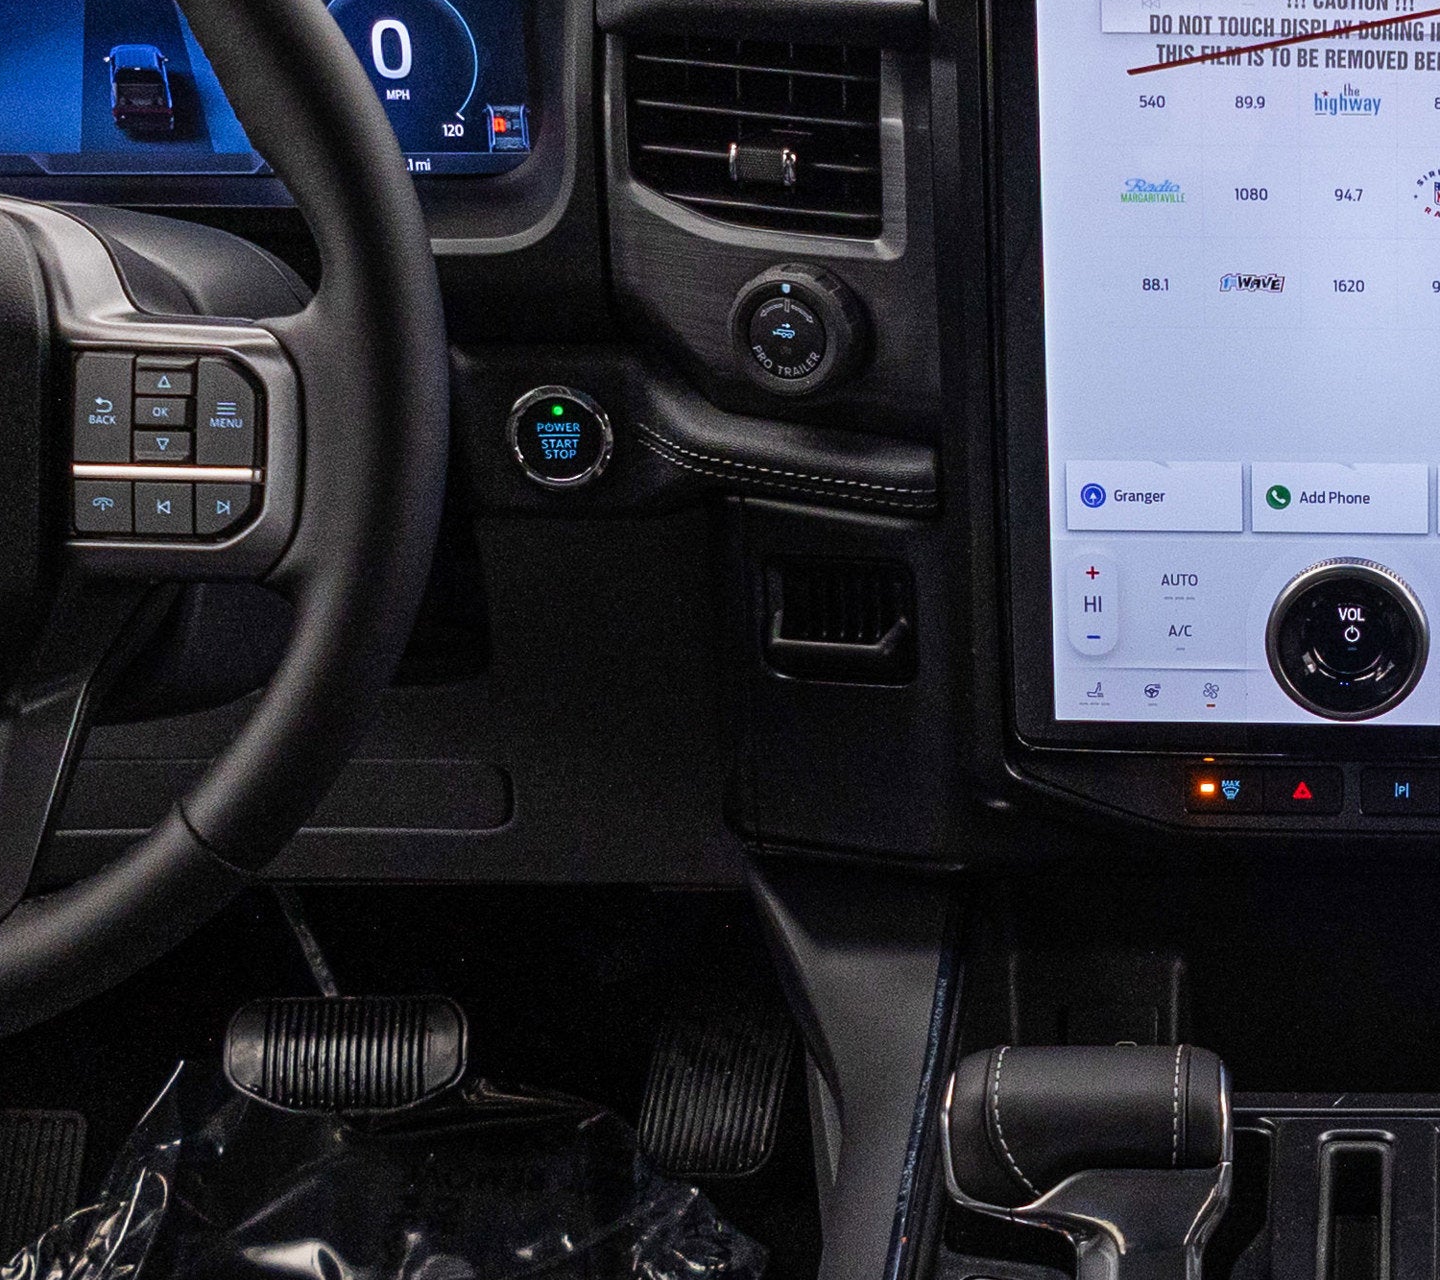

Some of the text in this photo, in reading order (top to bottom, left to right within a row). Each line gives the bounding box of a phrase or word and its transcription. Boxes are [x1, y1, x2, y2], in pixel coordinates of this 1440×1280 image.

[1149, 14, 1173, 35] DO
[1178, 15, 1213, 36] NOT
[1218, 16, 1275, 38] TOUCH
[1280, 18, 1352, 40] DISPLAY
[1357, 20, 1424, 42] DURING
[371, 19, 412, 80] 0
[1156, 43, 1195, 65] THIS
[1201, 45, 1242, 66] FILM
[1247, 47, 1265, 67] IS
[1270, 47, 1291, 68] TO
[1296, 48, 1319, 69] BE
[1324, 49, 1409, 71] REMOVED
[386, 89, 411, 101] MPH
[1343, 83, 1360, 96] the
[1139, 95, 1166, 109] 540
[1234, 95, 1266, 110] 89.9
[1313, 92, 1382, 116] highway
[442, 124, 465, 137] 120
[415, 158, 432, 171] mi
[1120, 193, 1186, 204] MARGARITAVILLE
[1234, 188, 1269, 202] 1080
[1334, 188, 1364, 203] 94.7
[1142, 278, 1170, 291] 88.1
[1333, 279, 1366, 293] 1620
[752, 344, 821, 377] PRO TRAILER
[152, 406, 170, 418] OK
[88, 414, 117, 426] BACK
[209, 417, 243, 429] MENU
[536, 422, 581, 433] POWER
[541, 437, 580, 450] START
[544, 448, 578, 460] STOP
[1113, 489, 1166, 504] Granger
[1299, 491, 1371, 505] Add Phone
[1161, 573, 1199, 587] AUTO
[1084, 595, 1103, 613] HI
[1337, 607, 1366, 622] VOL
[1168, 624, 1193, 638] A/C
